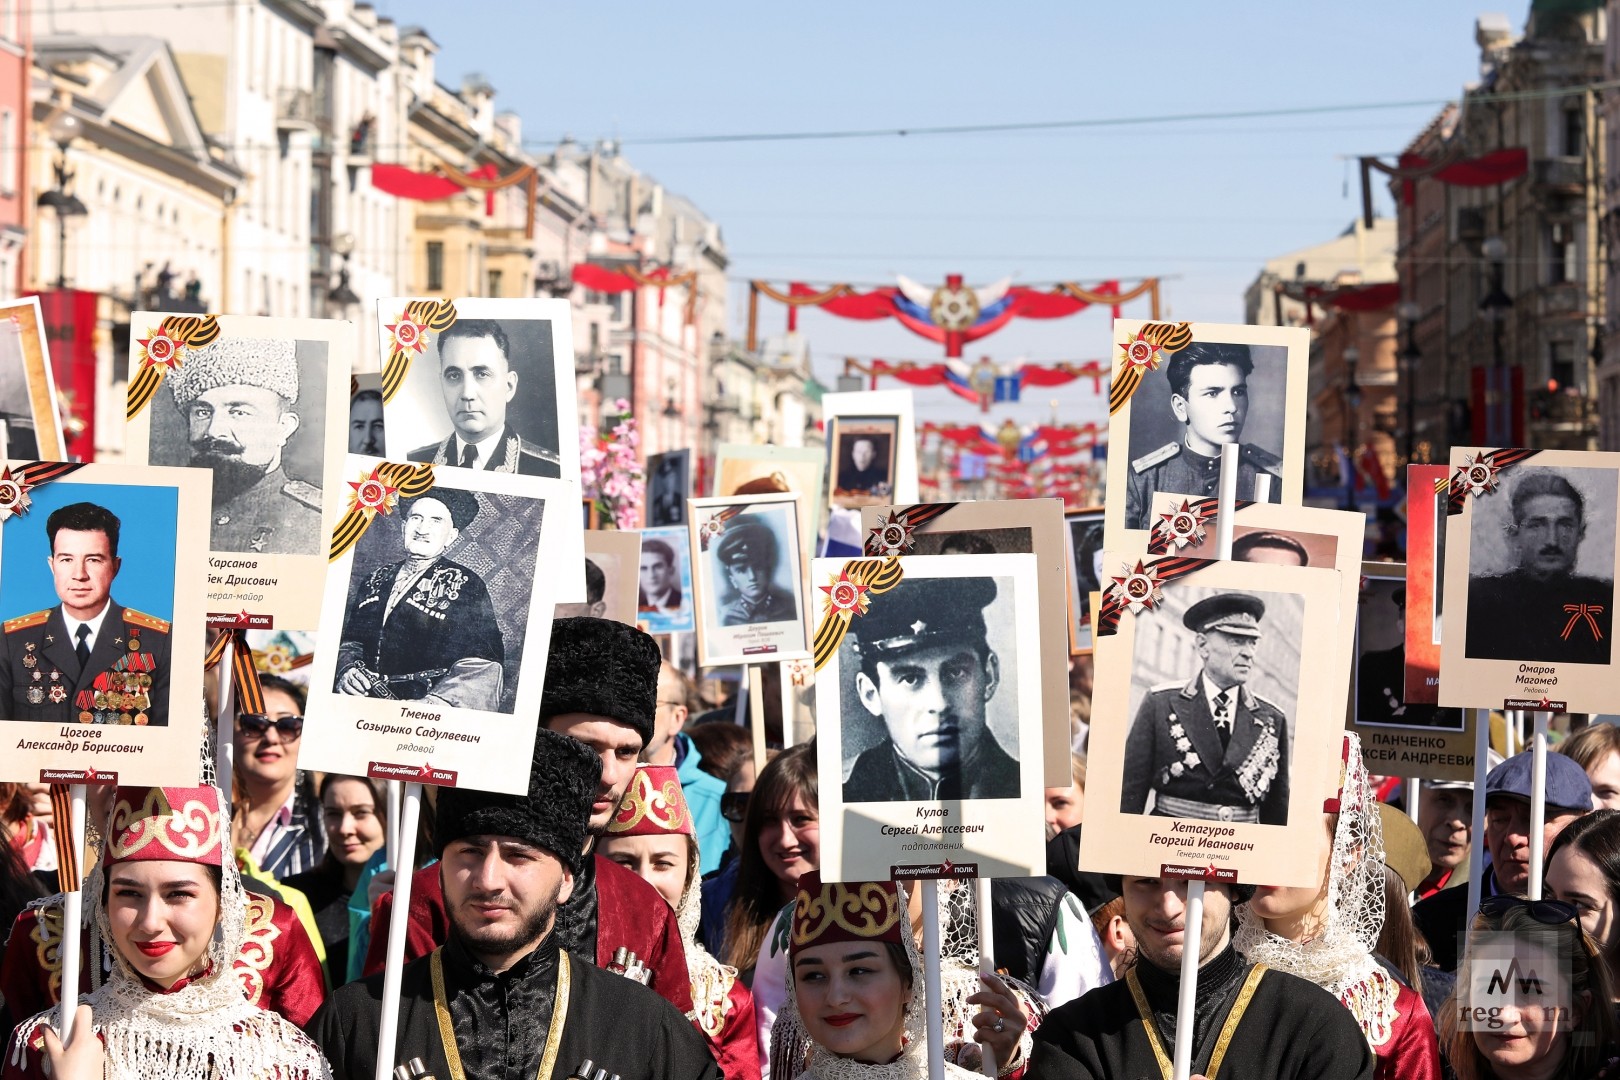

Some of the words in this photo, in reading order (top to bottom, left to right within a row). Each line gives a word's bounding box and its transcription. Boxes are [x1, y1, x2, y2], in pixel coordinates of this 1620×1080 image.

[208, 557, 258, 569] Карсанов
[225, 574, 278, 587] Дрисович
[1519, 664, 1556, 675] Омаров
[1515, 675, 1558, 685] Магомед
[1523, 686, 1549, 694] Рядовой
[400, 707, 442, 722] Тменов
[60, 727, 102, 738] Цогоев
[356, 719, 412, 735] Созырыко
[415, 726, 481, 743] Садулвевич
[17, 739, 79, 753] Александр
[82, 741, 144, 754] Борисович
[1372, 733, 1446, 749] ПАНЧЕНКО
[396, 742, 435, 754] рядовой
[916, 807, 949, 819] Кулов
[881, 824, 918, 837] Сергей
[921, 824, 985, 834] Алексеевич
[1170, 821, 1235, 837] Хетагуров
[901, 842, 964, 851] подполковник
[1149, 833, 1194, 847] Георгий
[1198, 837, 1254, 851] Иванович
[1176, 850, 1205, 859] Генерал
